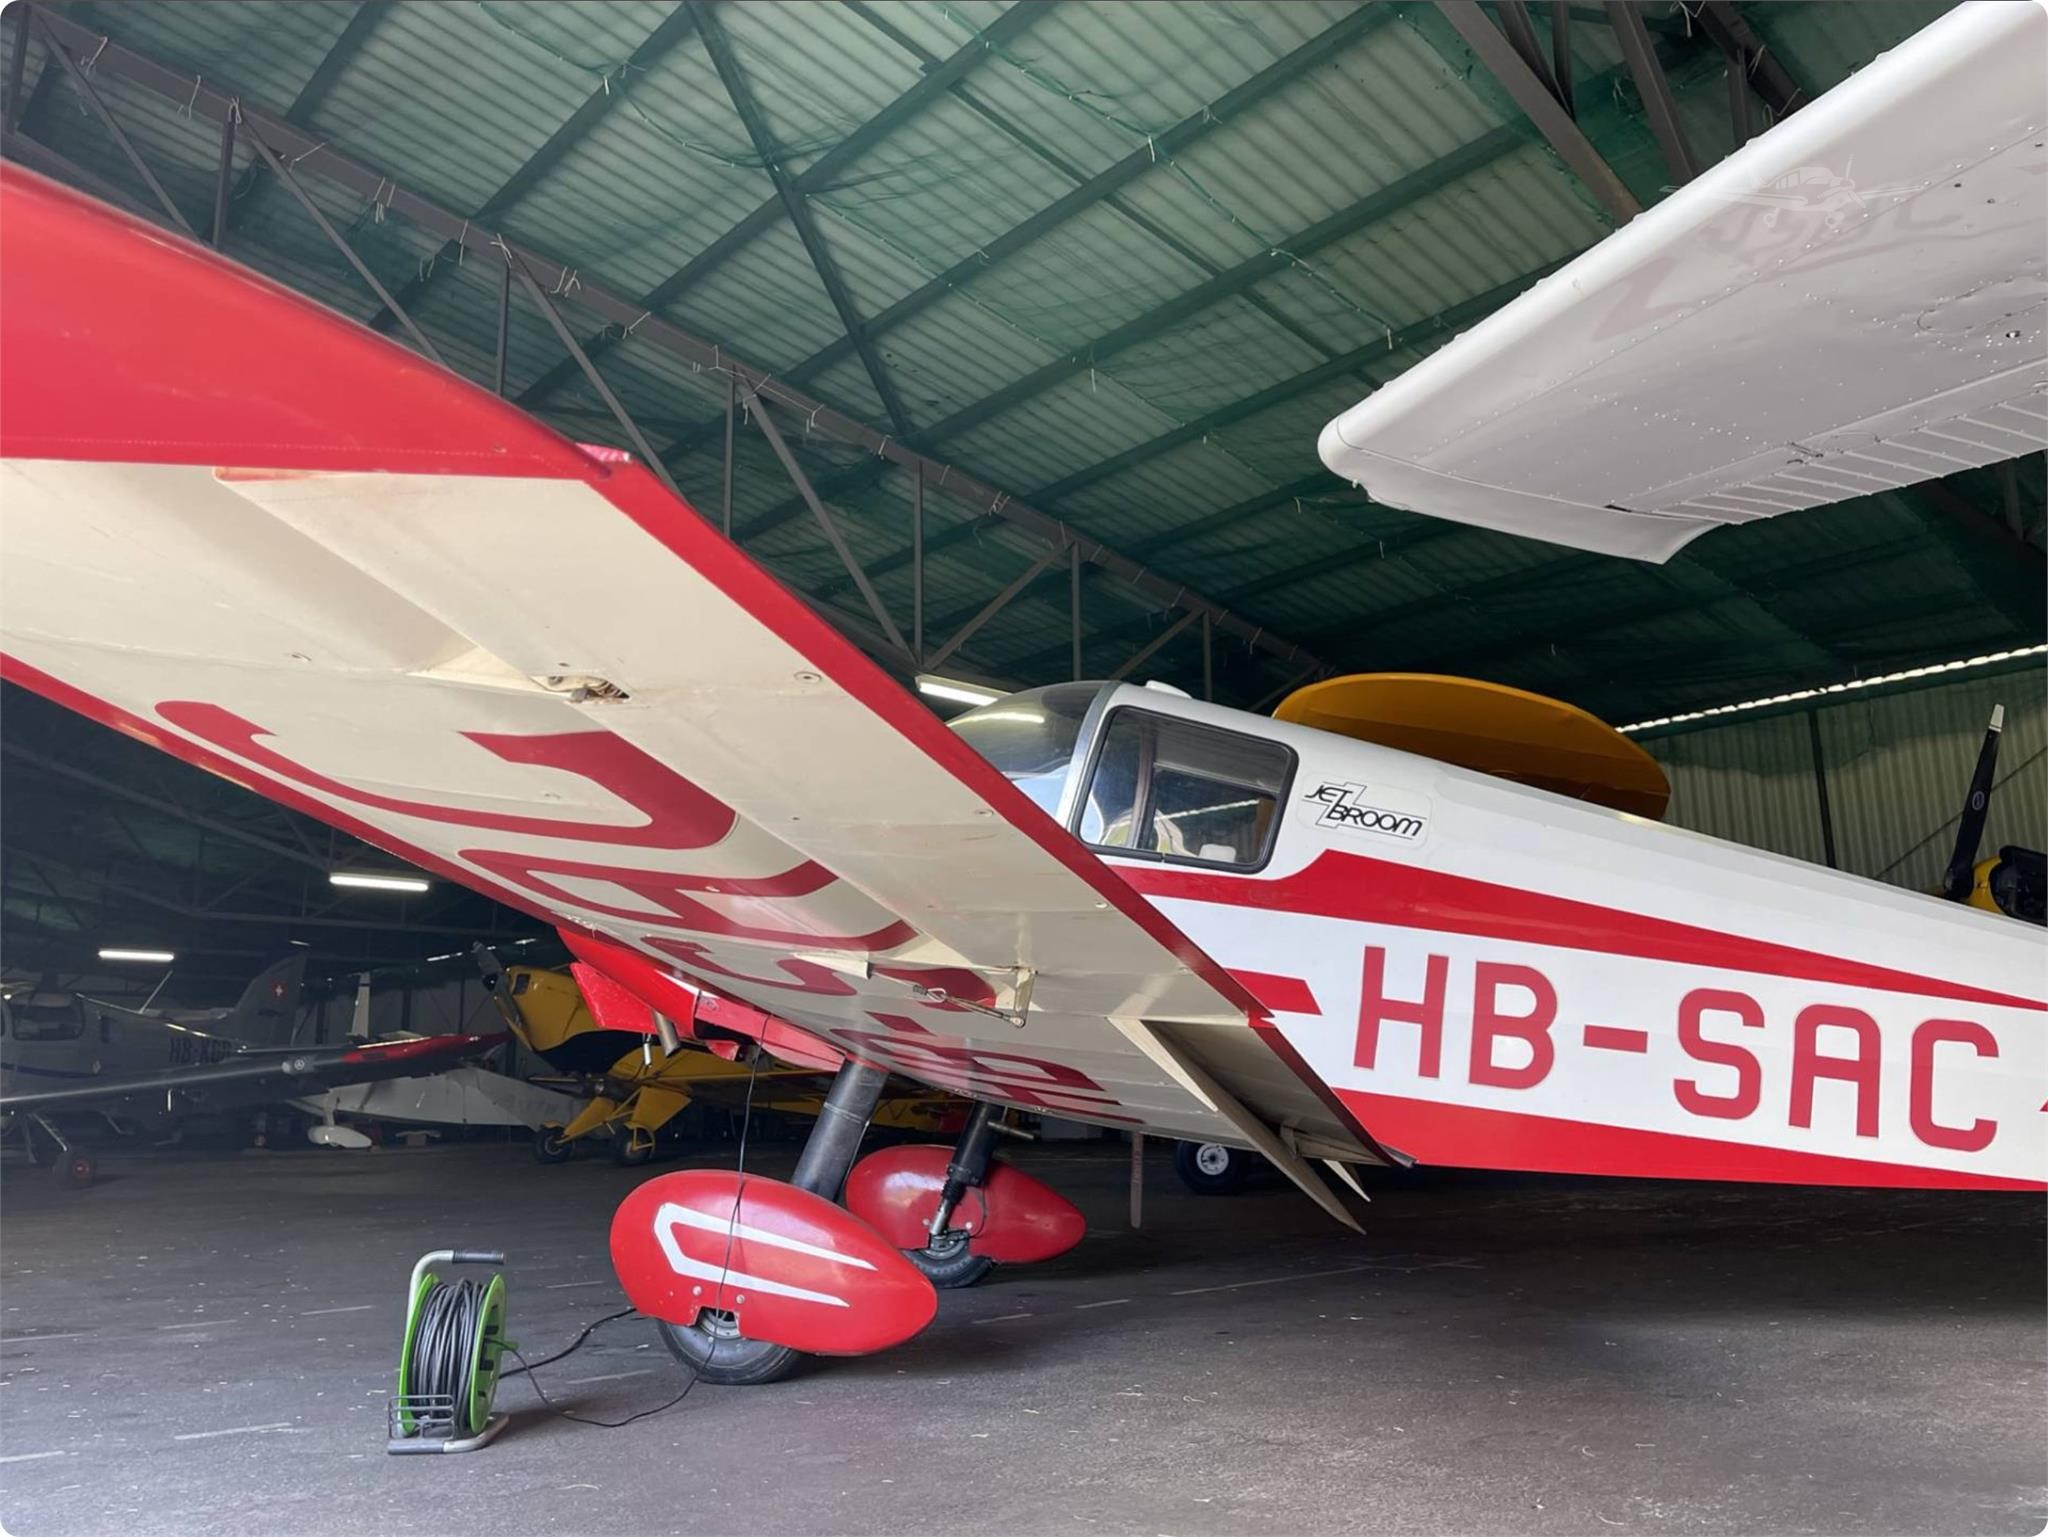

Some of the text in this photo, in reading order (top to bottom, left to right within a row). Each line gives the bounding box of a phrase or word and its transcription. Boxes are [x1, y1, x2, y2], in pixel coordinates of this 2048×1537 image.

[1304, 784, 1353, 806] JET
[1326, 804, 1423, 837] BROOM
[1353, 945, 2000, 1152] HB-SAC
